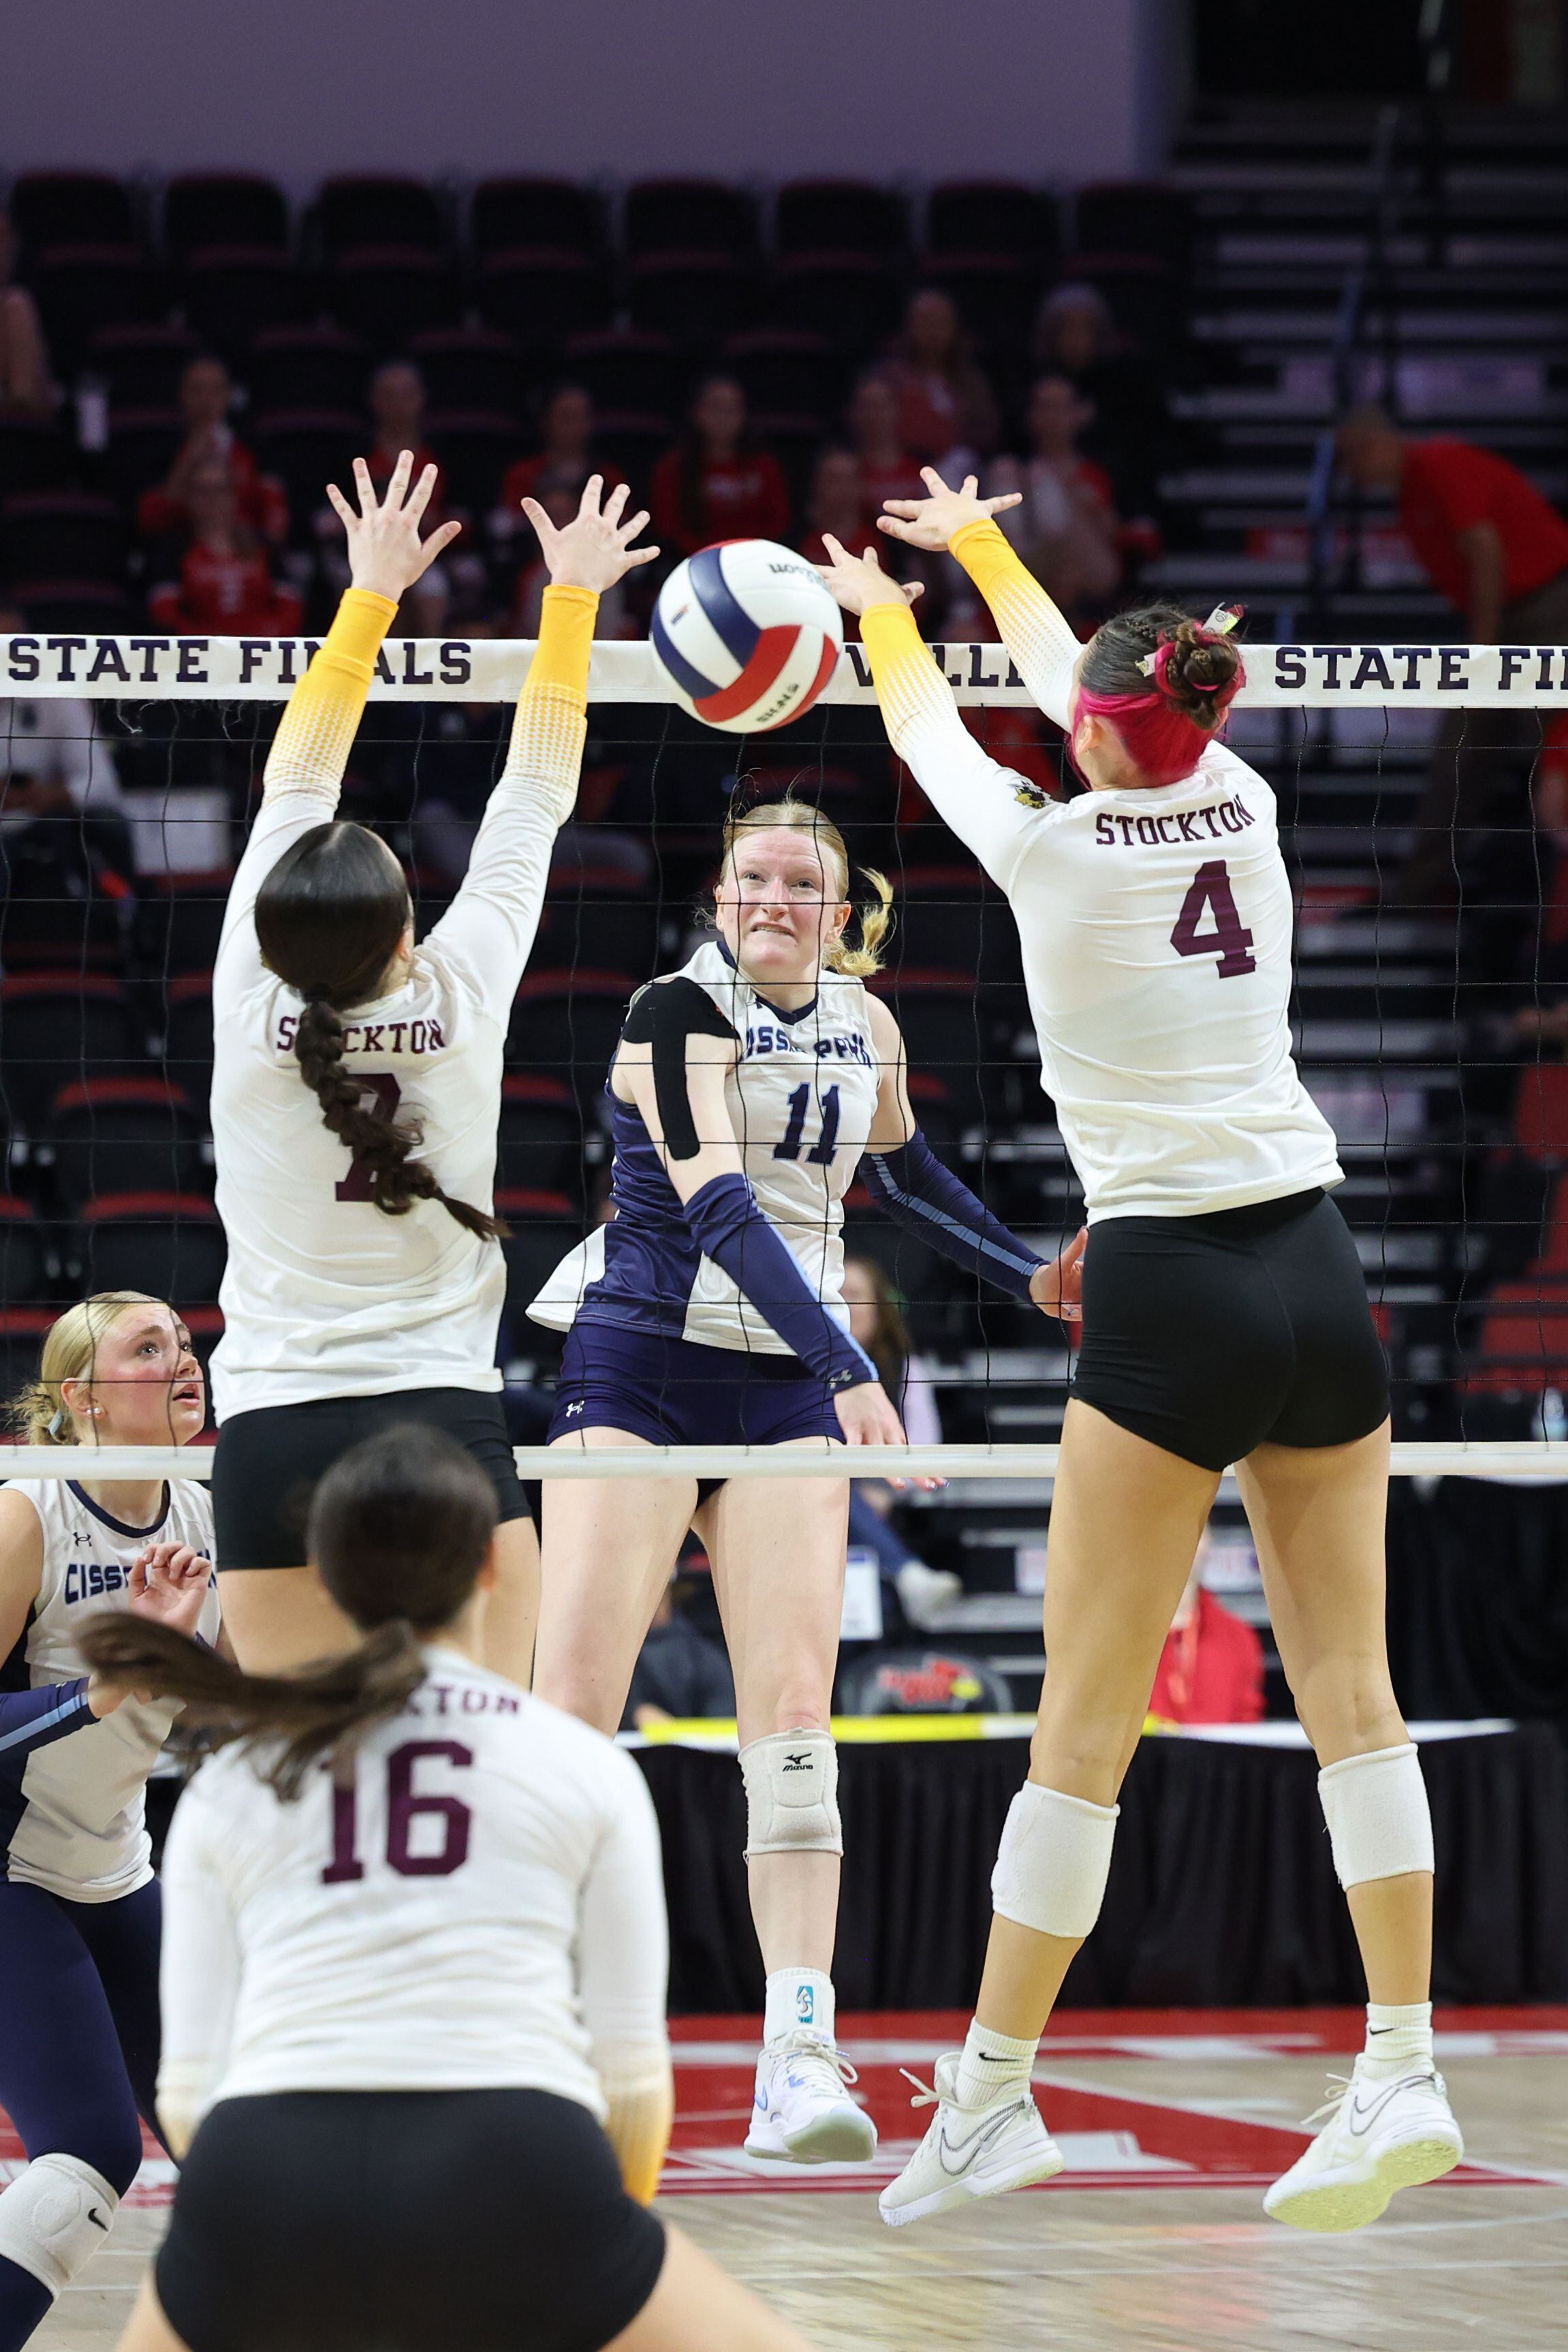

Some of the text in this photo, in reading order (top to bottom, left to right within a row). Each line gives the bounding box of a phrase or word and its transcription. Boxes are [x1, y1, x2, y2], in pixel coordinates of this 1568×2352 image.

[8, 638, 209, 683] STATE
[1274, 646, 1568, 690] STATE FI
[1095, 792, 1256, 846] STOCKTON
[1170, 858, 1257, 979] 4
[277, 1015, 446, 1055] SCKTON
[772, 1081, 841, 1167] 11
[319, 1739, 474, 1885] 16
